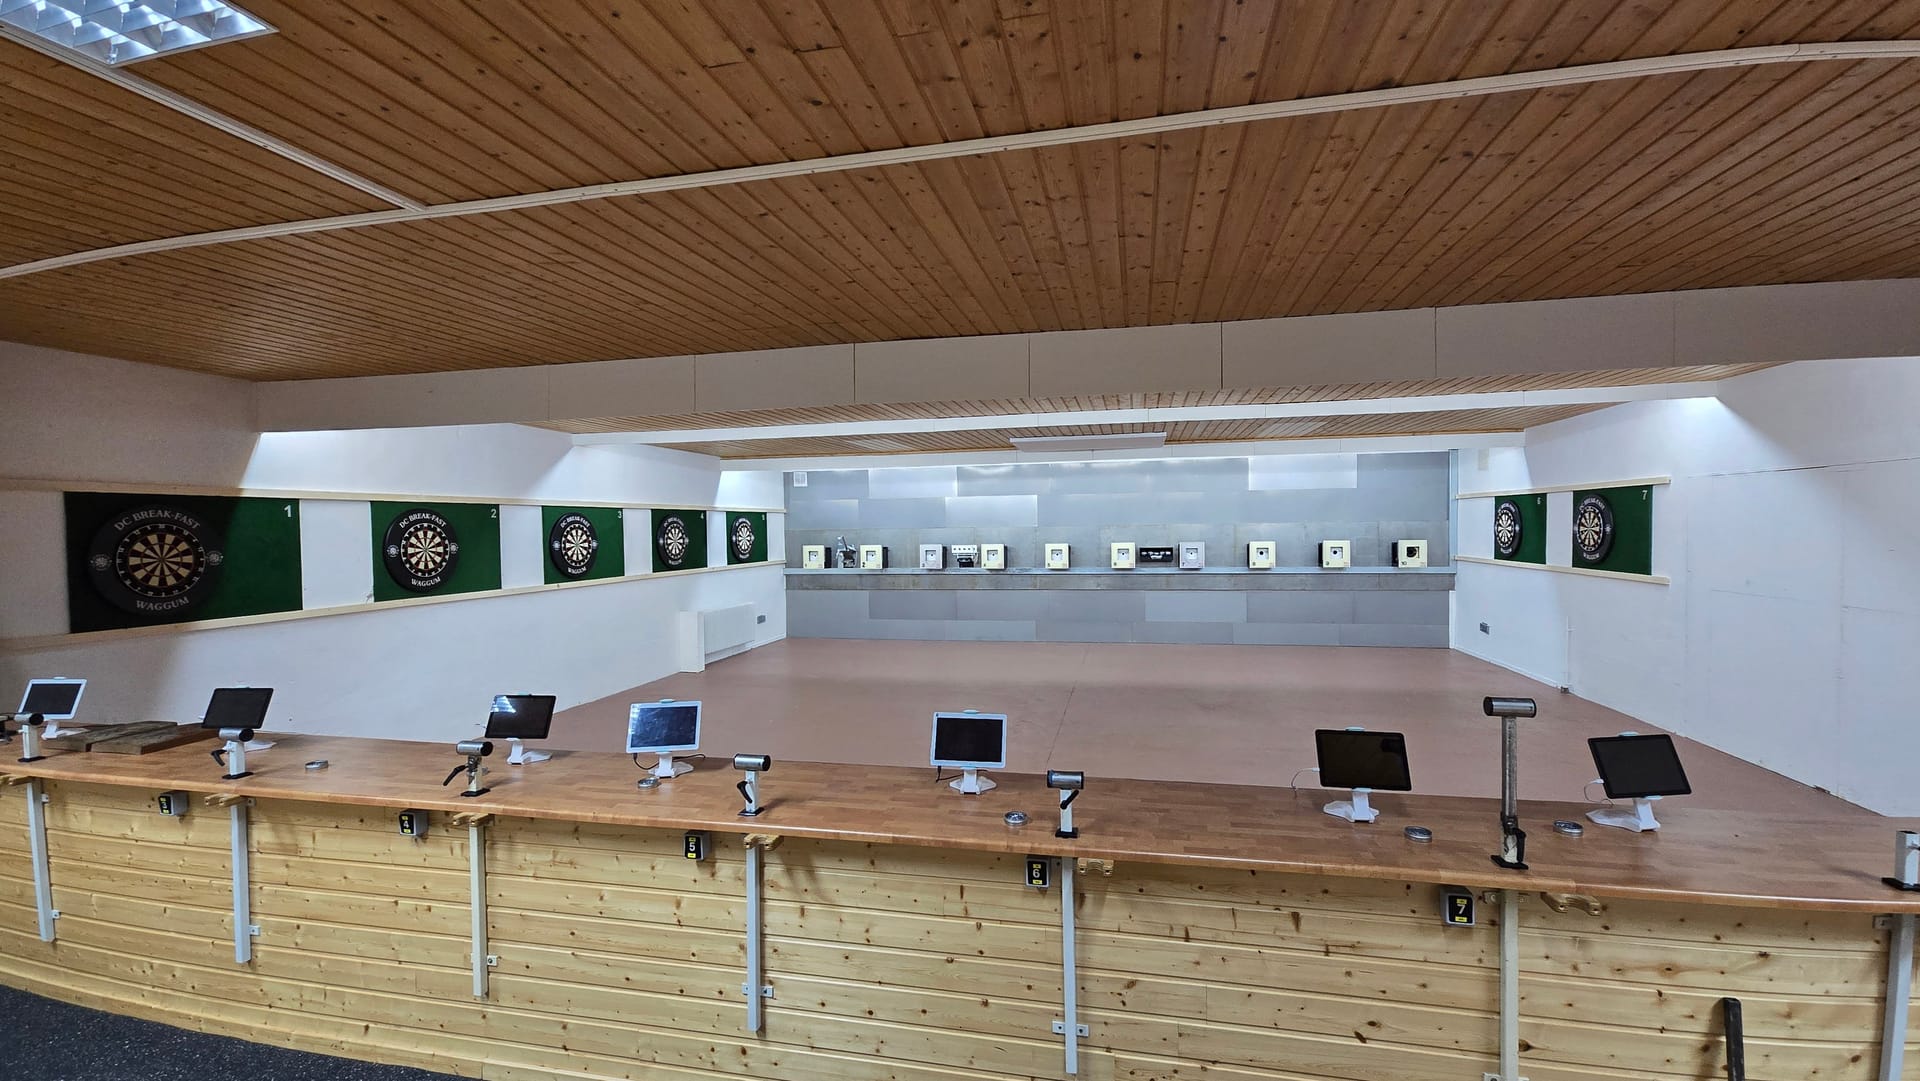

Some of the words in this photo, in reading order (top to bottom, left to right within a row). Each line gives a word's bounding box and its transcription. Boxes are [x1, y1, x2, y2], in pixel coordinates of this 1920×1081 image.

[1642, 489, 1648, 500] 7
[284, 504, 293, 518] 1
[490, 508, 497, 519] 2
[617, 510, 622, 519] 3
[114, 516, 133, 531] DC
[132, 509, 201, 530] BREAK-FAST
[399, 518, 409, 529] DC
[409, 512, 447, 528] BREAK-FAST
[411, 576, 441, 587] WAGGUM
[135, 595, 190, 611] WAGGUM
[403, 820, 410, 829] 4
[689, 842, 696, 851] 5
[1032, 868, 1041, 878] 6
[1457, 903, 1466, 914] 7
